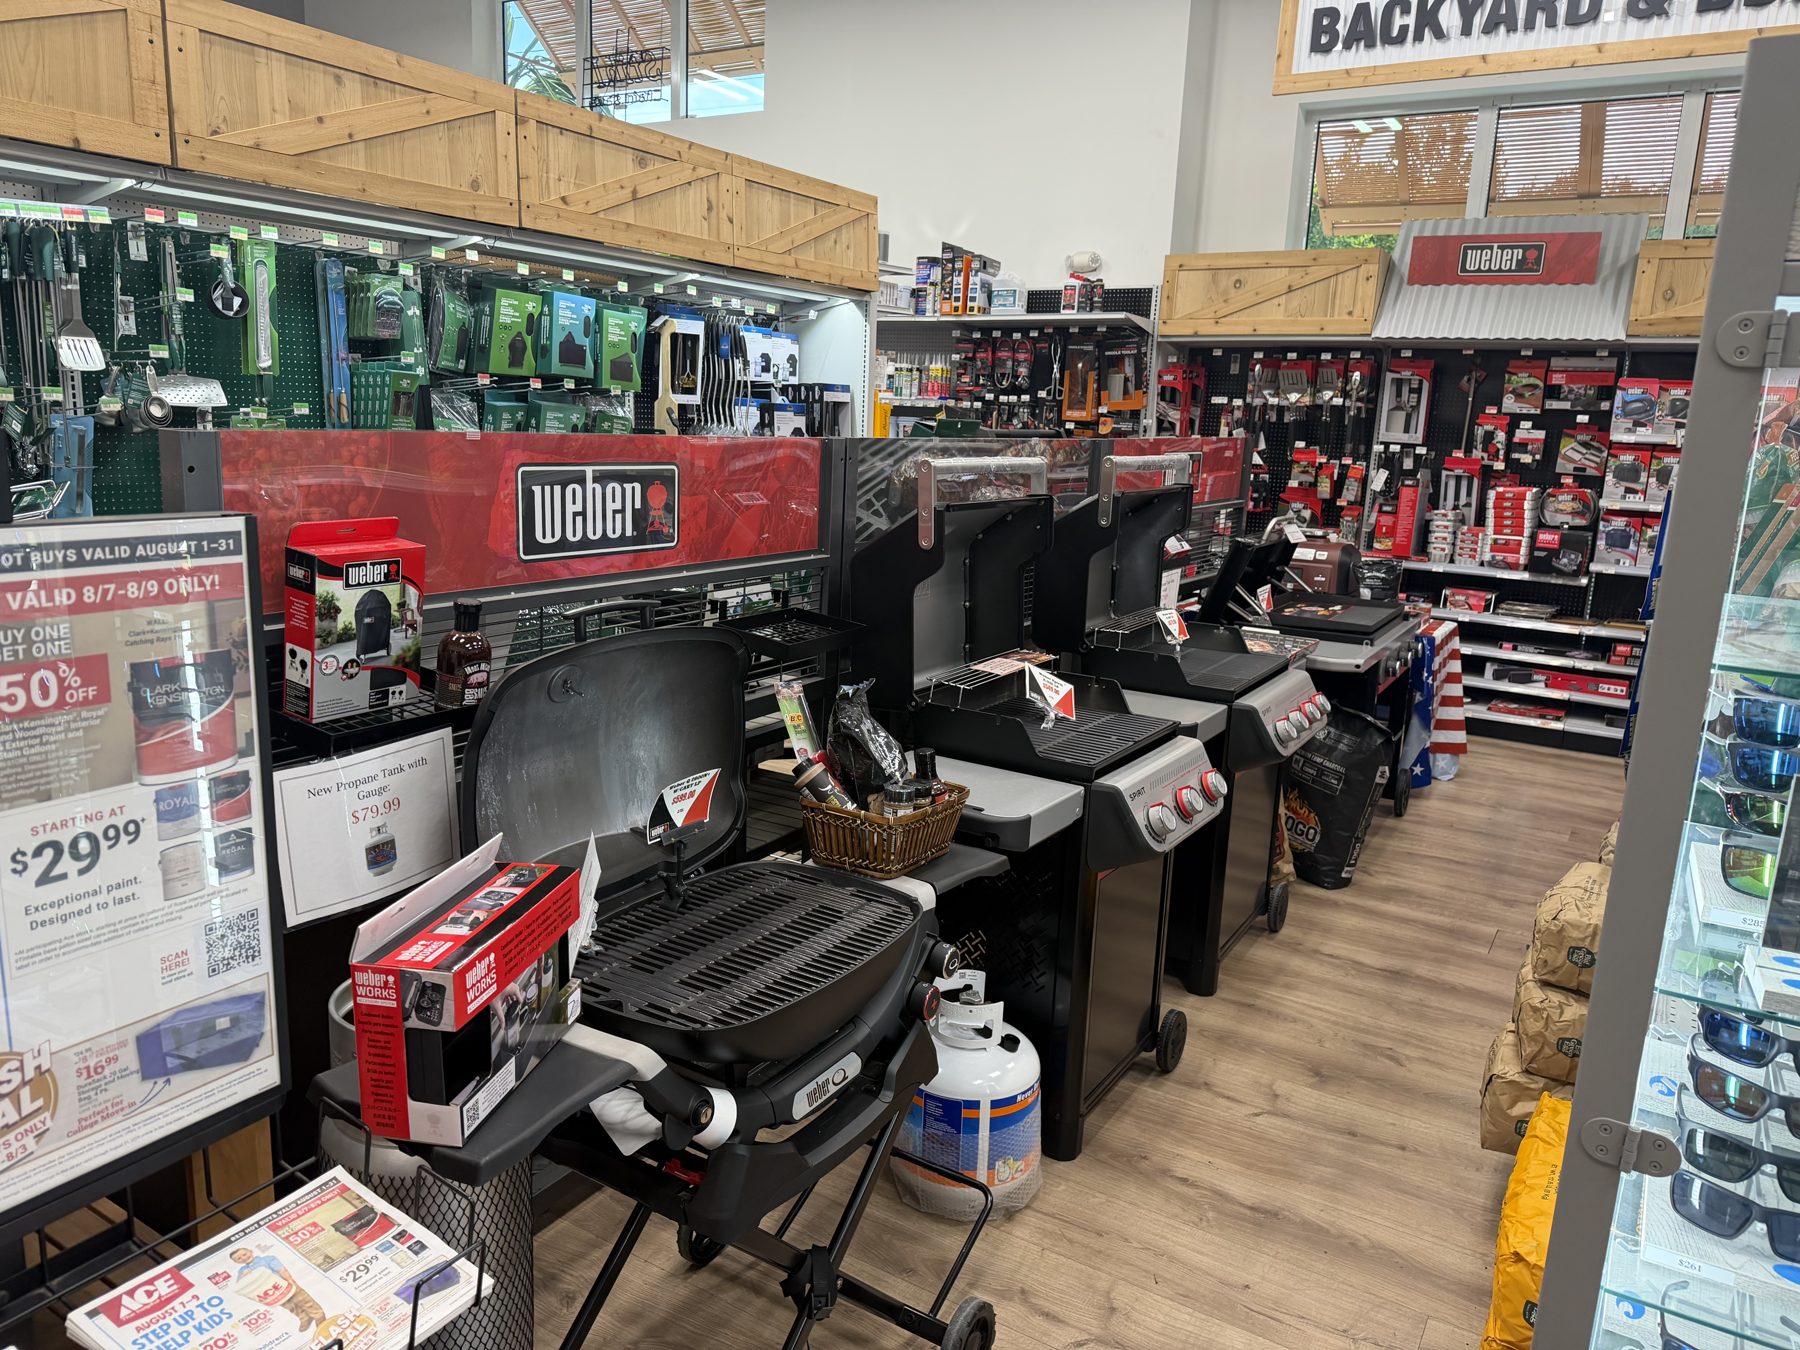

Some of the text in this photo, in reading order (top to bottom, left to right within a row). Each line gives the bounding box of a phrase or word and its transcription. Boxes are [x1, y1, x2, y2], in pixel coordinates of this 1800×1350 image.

[1309, 0, 1601, 53] BACKYARD
[1465, 243, 1522, 271] weber
[532, 468, 642, 545] weber
[0, 552, 25, 568] OT
[30, 548, 77, 565] BUYS
[82, 543, 131, 560] VALID
[136, 540, 198, 557] AUGUST
[348, 561, 388, 586] weber
[5, 574, 220, 611] VALID 8/7-8/9 ONLY!
[0, 623, 71, 644] UY ONE
[0, 639, 71, 662] ET ONE
[65, 686, 98, 704] OFF
[306, 756, 428, 799] New Propane Tank with
[159, 794, 194, 811] ROYAL
[357, 784, 391, 802] Gauge:
[1128, 786, 1147, 802] SPIRIT
[30, 805, 127, 837] STARTING AT
[351, 797, 401, 825] $79.99
[1284, 815, 1318, 843] OGO
[24, 876, 143, 917] Exceptional paint.
[30, 892, 141, 932] Designed to last.
[160, 949, 189, 966] SCAN
[160, 958, 191, 975] HERE!
[354, 969, 387, 987] weber
[465, 955, 490, 989] weber
[466, 969, 497, 1003] WORKS
[356, 985, 397, 1000] WORKS
[806, 1077, 832, 1108] weber
[77, 1098, 124, 1126] Perfect for
[14, 1116, 48, 1143] ONLY
[66, 1119, 99, 1139] College
[1678, 1259, 1702, 1273] $261
[119, 1273, 179, 1320] ACE
[256, 1281, 284, 1302] ACE
[131, 1322, 172, 1350] STEP
[172, 1308, 197, 1327] UP
[195, 1295, 224, 1315] TO
[135, 1306, 178, 1334] AUGUST
[192, 1307, 234, 1336] KIDS
